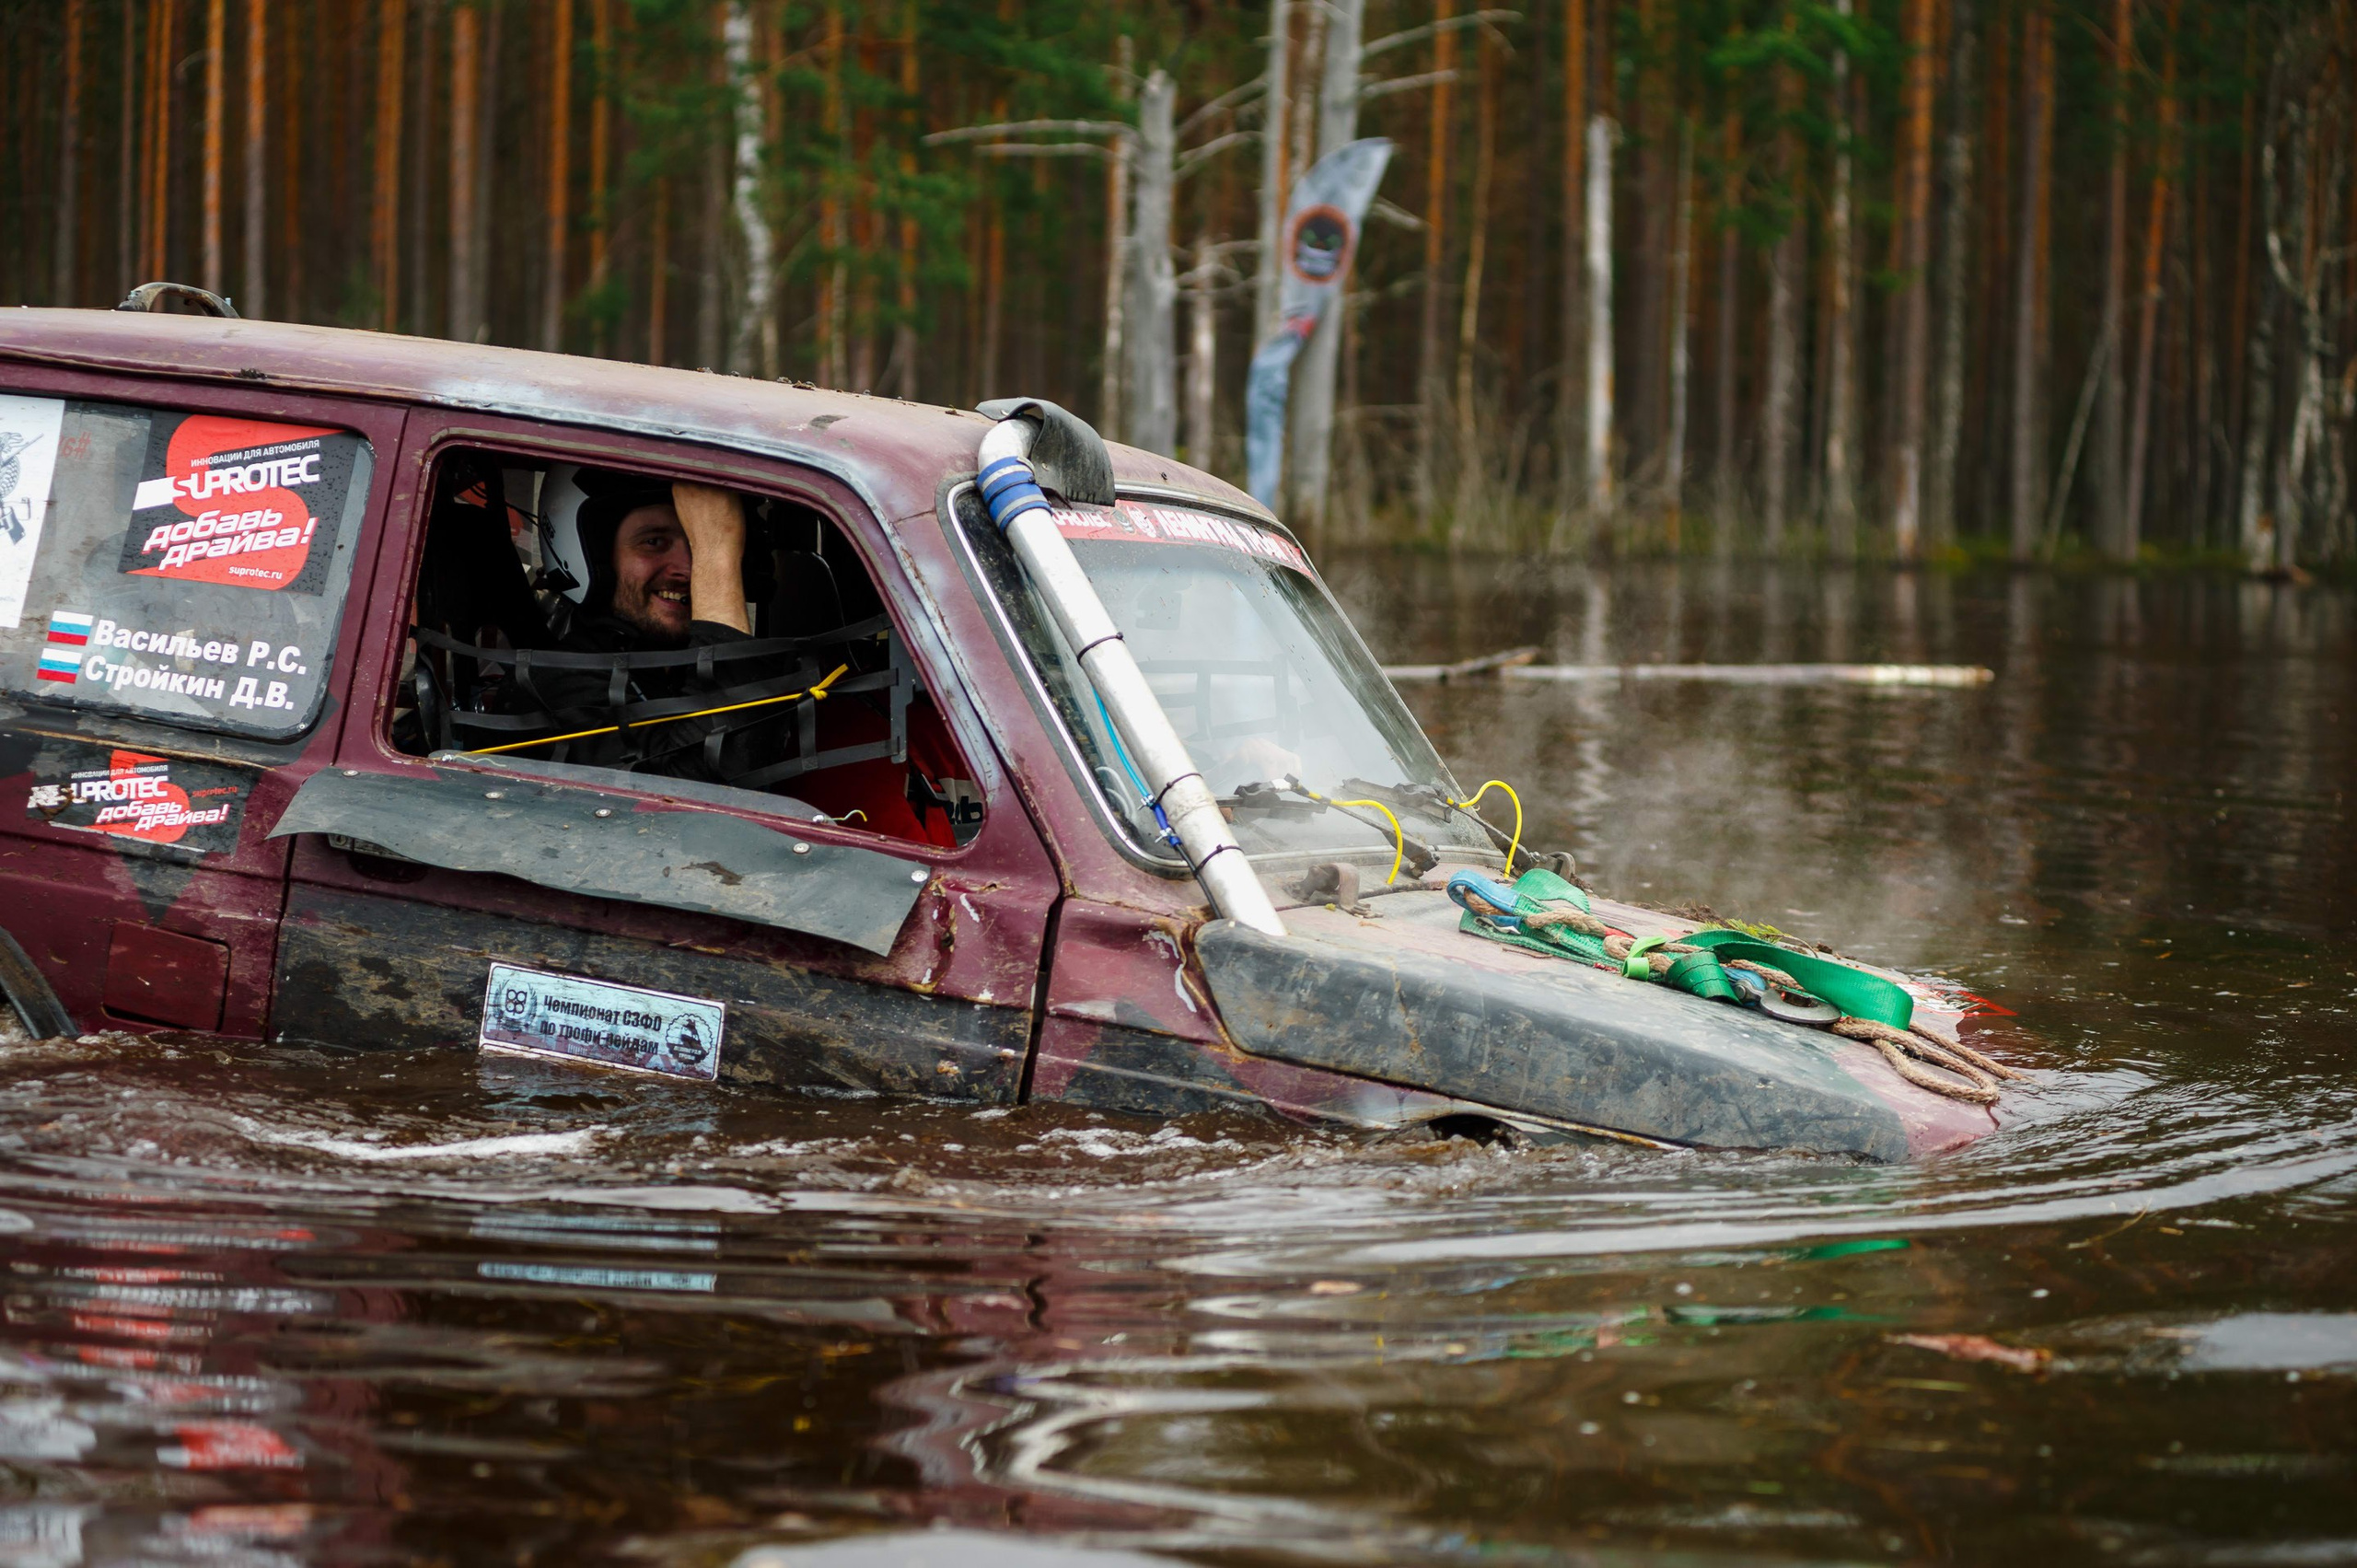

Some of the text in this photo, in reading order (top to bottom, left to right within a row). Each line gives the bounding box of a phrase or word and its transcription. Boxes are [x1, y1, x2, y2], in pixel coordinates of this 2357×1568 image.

[190, 439, 319, 468] ИННОВАЦИИ ДЛЯ АВТОМОБИЛЯ
[169, 454, 320, 500] SUPROTEC
[142, 508, 283, 554] добавь
[157, 517, 319, 572] драйва!
[228, 565, 283, 580] suprotec.ru
[93, 619, 307, 675] Васильев Р.С.
[85, 655, 295, 710] Стройкин Д.В.
[96, 800, 182, 824] добавь
[134, 803, 229, 832] драйва!
[540, 1019, 556, 1036] по
[543, 994, 663, 1032] Чемпионат СЗФО
